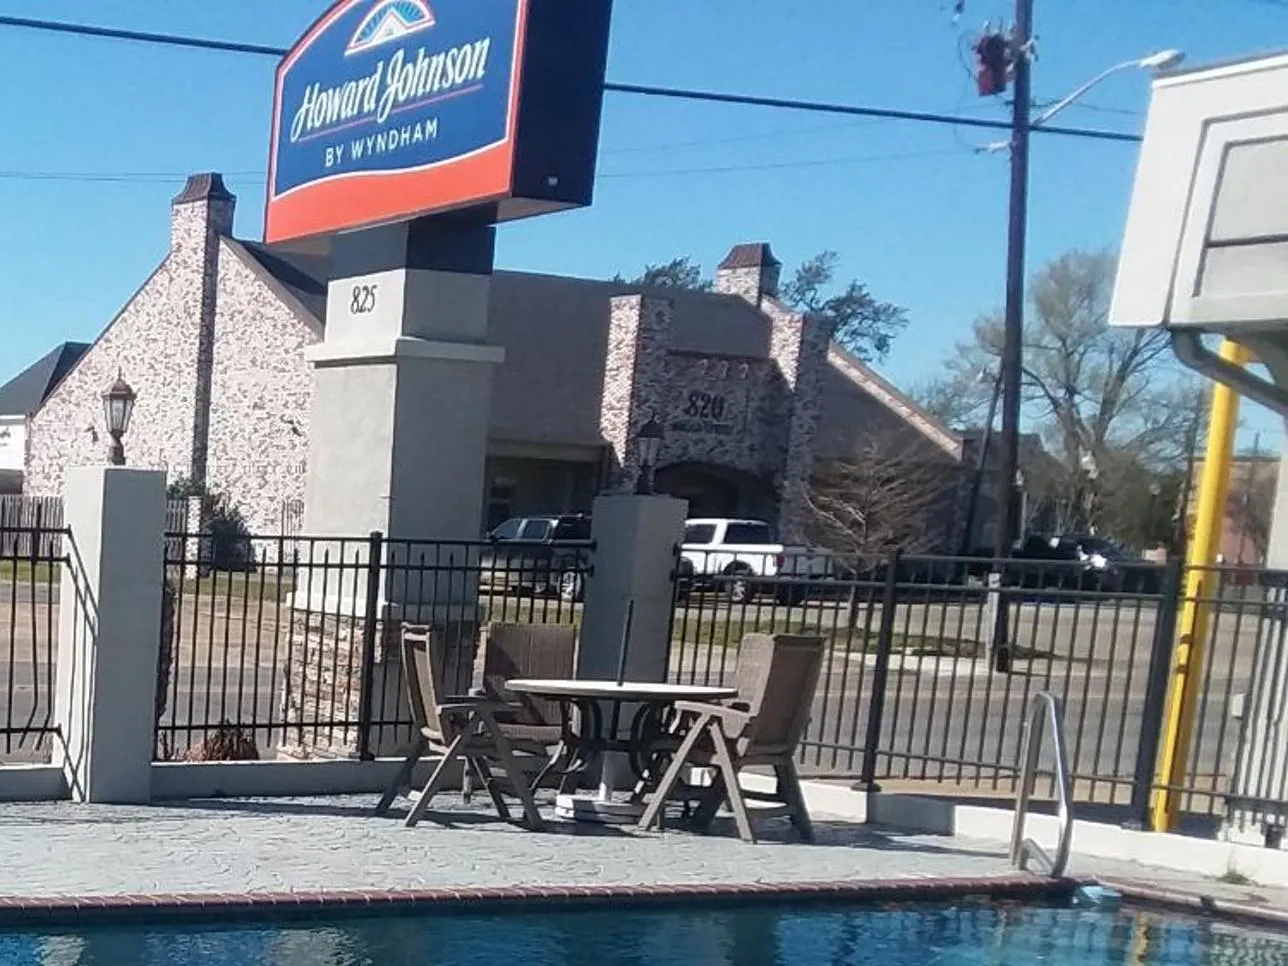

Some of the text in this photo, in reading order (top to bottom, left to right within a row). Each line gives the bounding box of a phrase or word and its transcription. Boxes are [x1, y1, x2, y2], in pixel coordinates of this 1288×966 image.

[290, 36, 490, 142] Howard Johnson
[325, 118, 438, 167] BY WYNDHAM
[351, 285, 377, 314] 825
